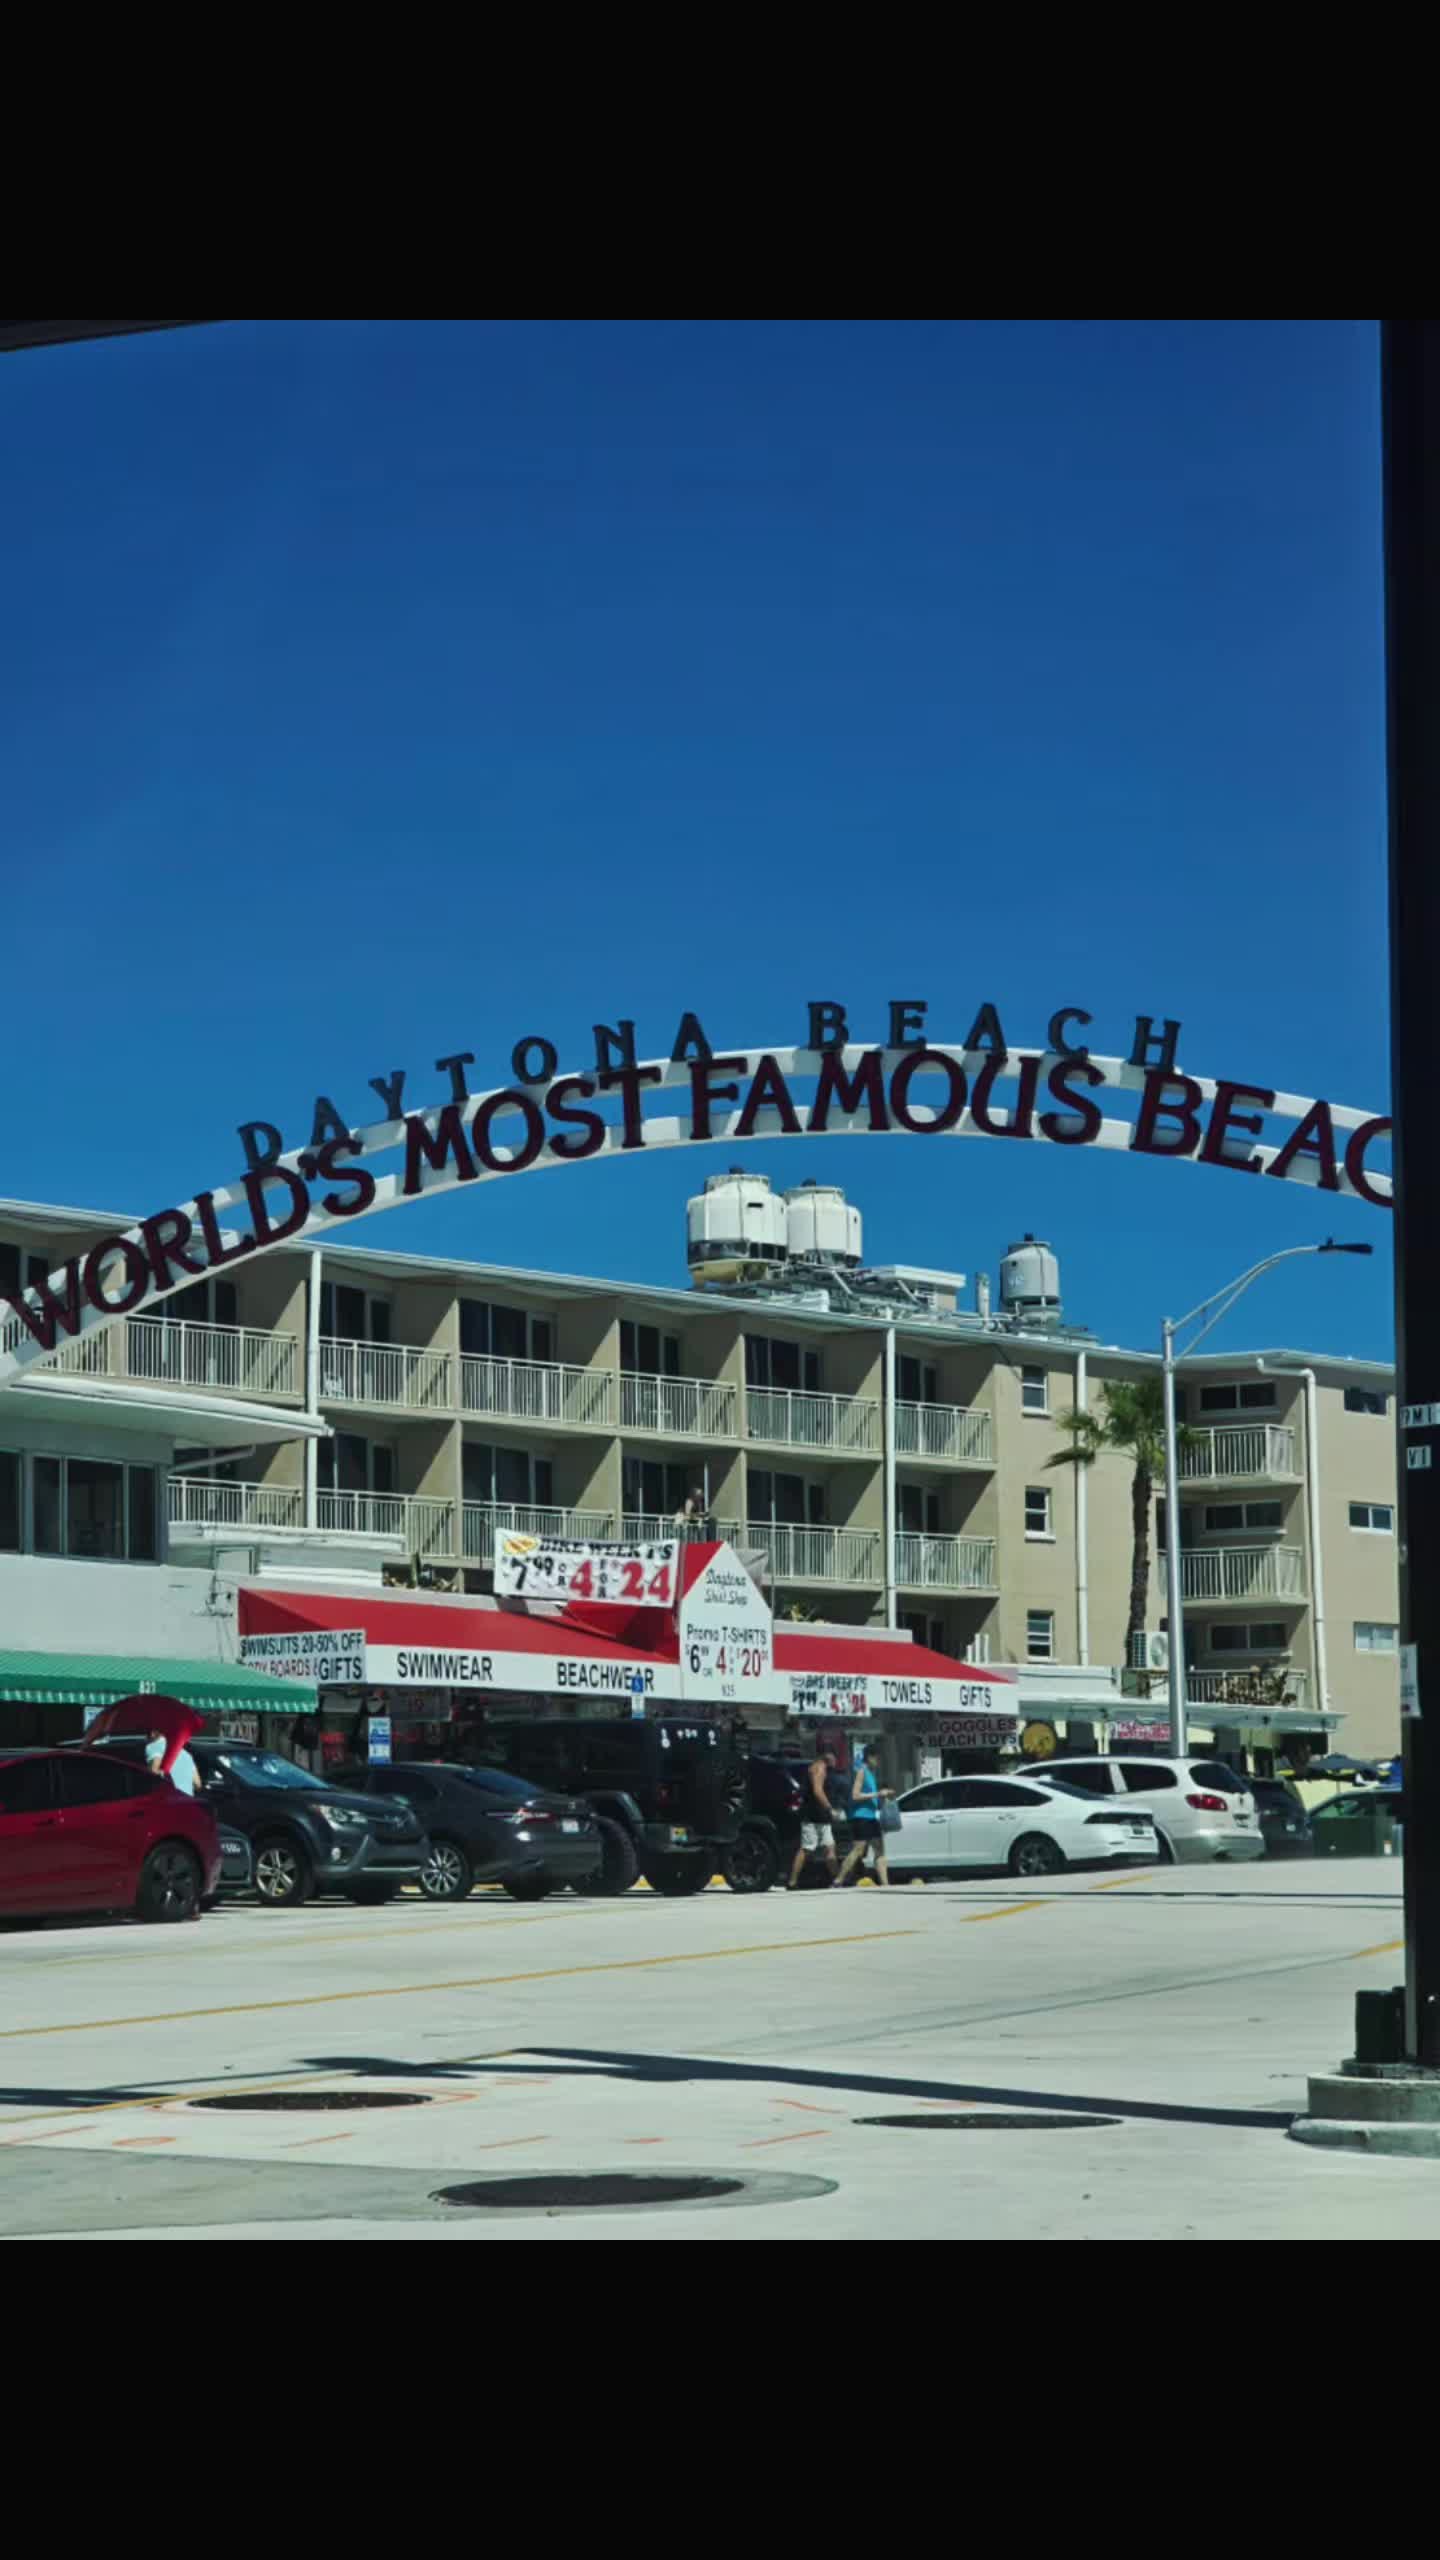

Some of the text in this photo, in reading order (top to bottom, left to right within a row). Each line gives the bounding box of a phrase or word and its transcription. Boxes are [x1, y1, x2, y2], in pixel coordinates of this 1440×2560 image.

[237, 1000, 1181, 1170] DAYTONA BEACH
[3, 1049, 1394, 1351] WORLD'S MOST FAMOUS BEAC
[240, 1635, 299, 1657] SWIMSUITS
[340, 1630, 363, 1652] OFF
[320, 1655, 363, 1680] GIFTS
[397, 1651, 494, 1681] SWIMWEAR
[881, 1680, 992, 1708] TOWELS GIFTS
